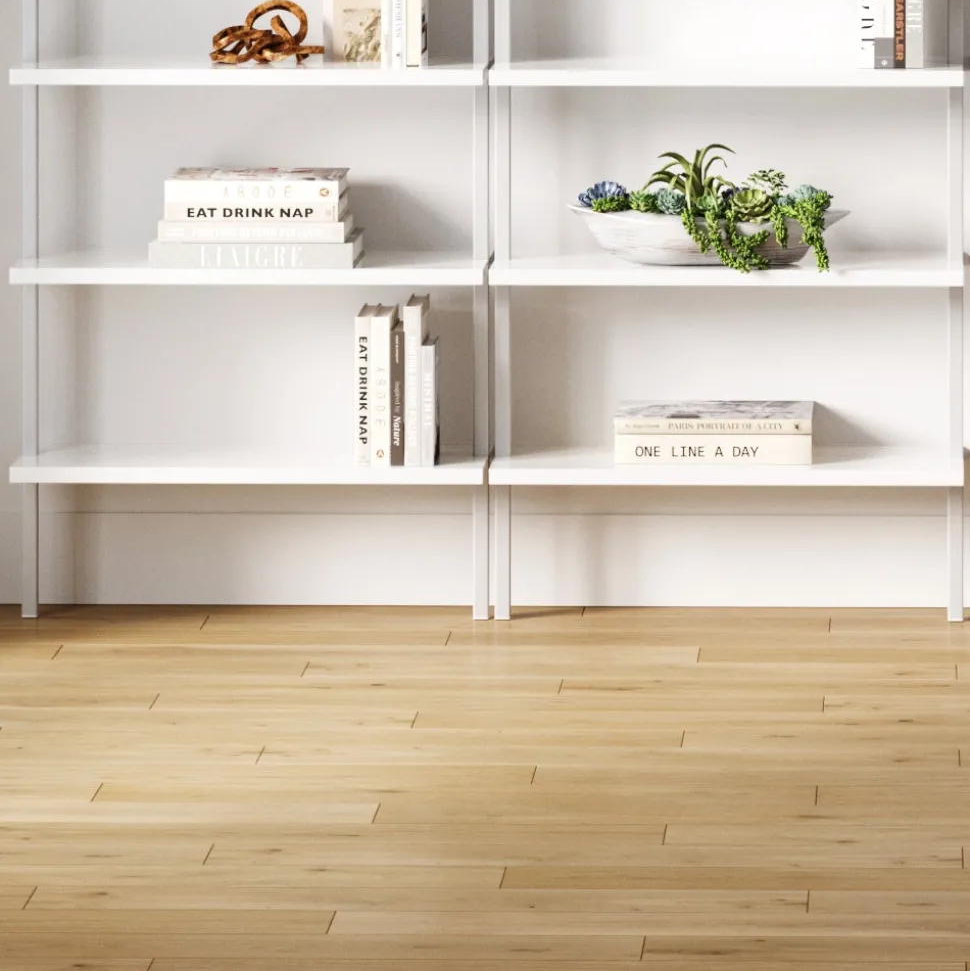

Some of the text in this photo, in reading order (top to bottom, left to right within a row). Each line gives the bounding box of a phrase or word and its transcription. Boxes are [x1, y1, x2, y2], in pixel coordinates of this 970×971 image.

[187, 208, 217, 218] EAT
[222, 208, 274, 218] DRINK
[280, 208, 314, 218] NAP
[358, 336, 368, 445] EAT DRINK NAP
[393, 415, 402, 446] Nature
[635, 445, 760, 458] ONE LINE A DAY
